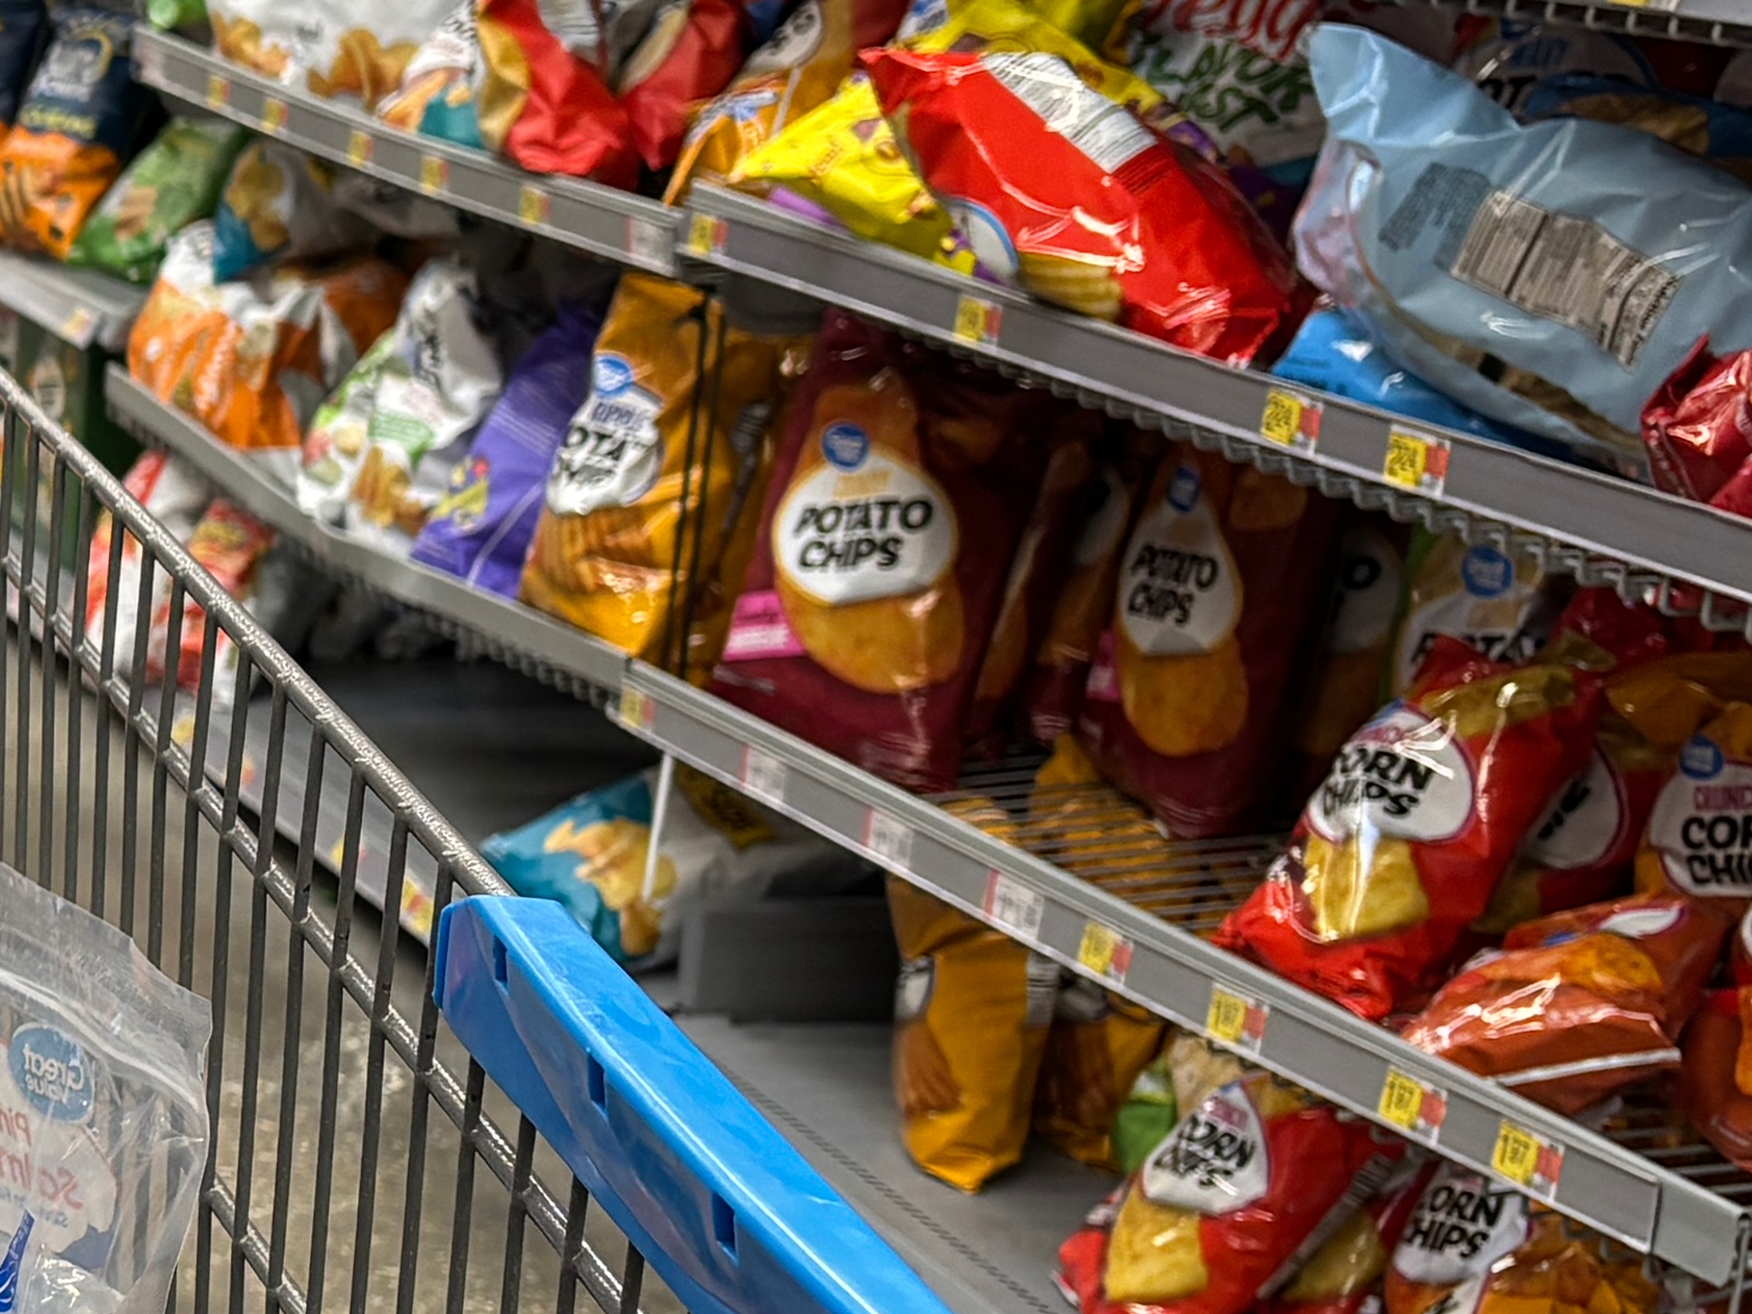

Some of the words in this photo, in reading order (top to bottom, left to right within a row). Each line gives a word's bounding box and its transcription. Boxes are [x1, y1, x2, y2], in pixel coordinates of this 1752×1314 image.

[792, 498, 934, 540] POTATO
[797, 537, 904, 574] CHIPS
[1129, 545, 1220, 594] POTATO
[1126, 583, 1193, 628] CHIPS
